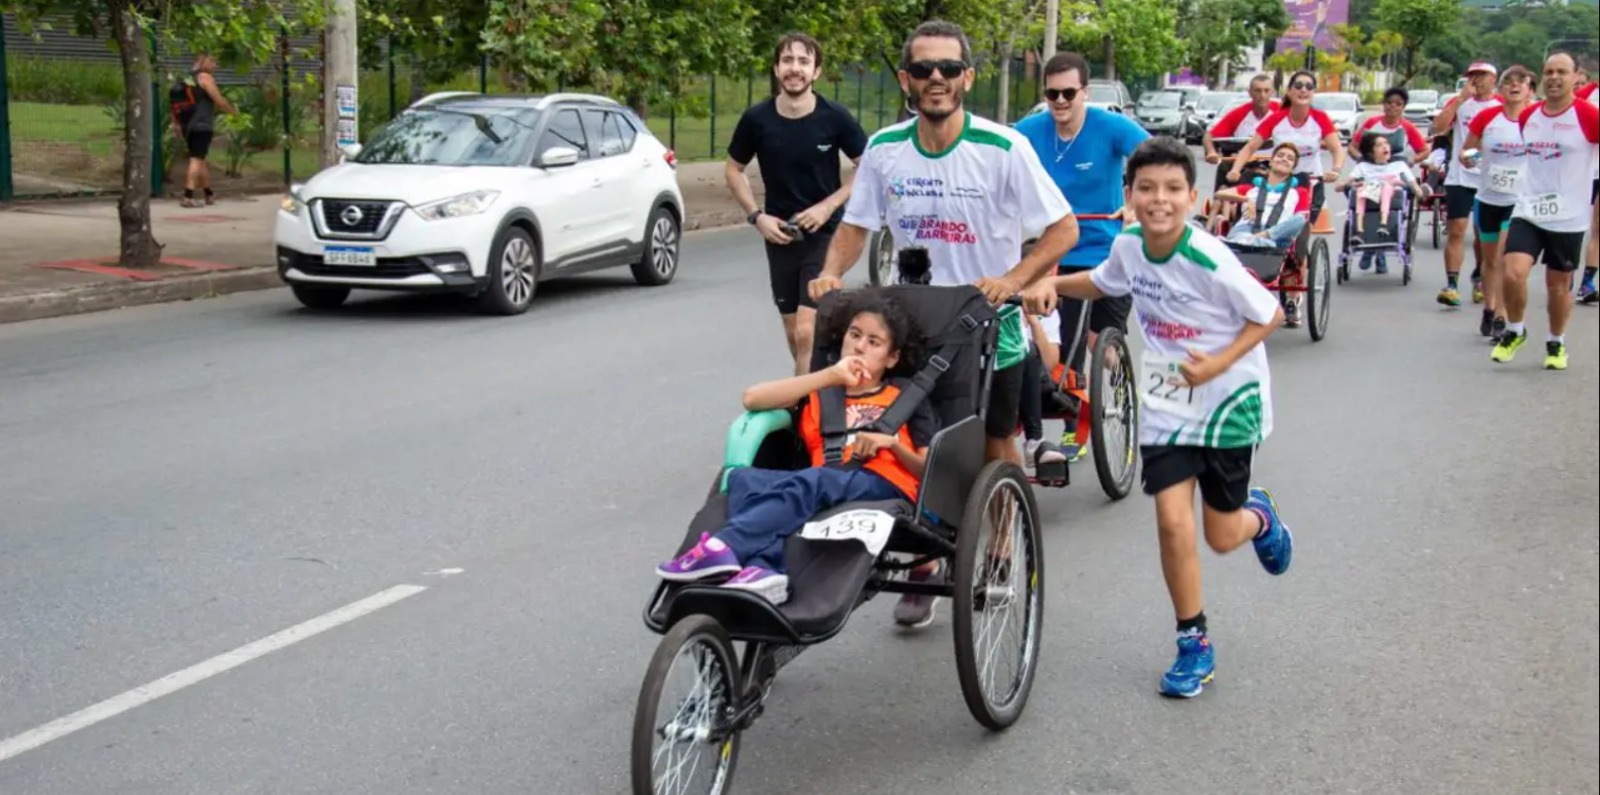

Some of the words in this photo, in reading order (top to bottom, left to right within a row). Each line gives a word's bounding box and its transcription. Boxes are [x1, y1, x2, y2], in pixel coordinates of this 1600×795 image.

[1532, 202, 1558, 216] 160
[916, 229, 977, 244] BARREIRAS
[820, 519, 876, 537] 139
